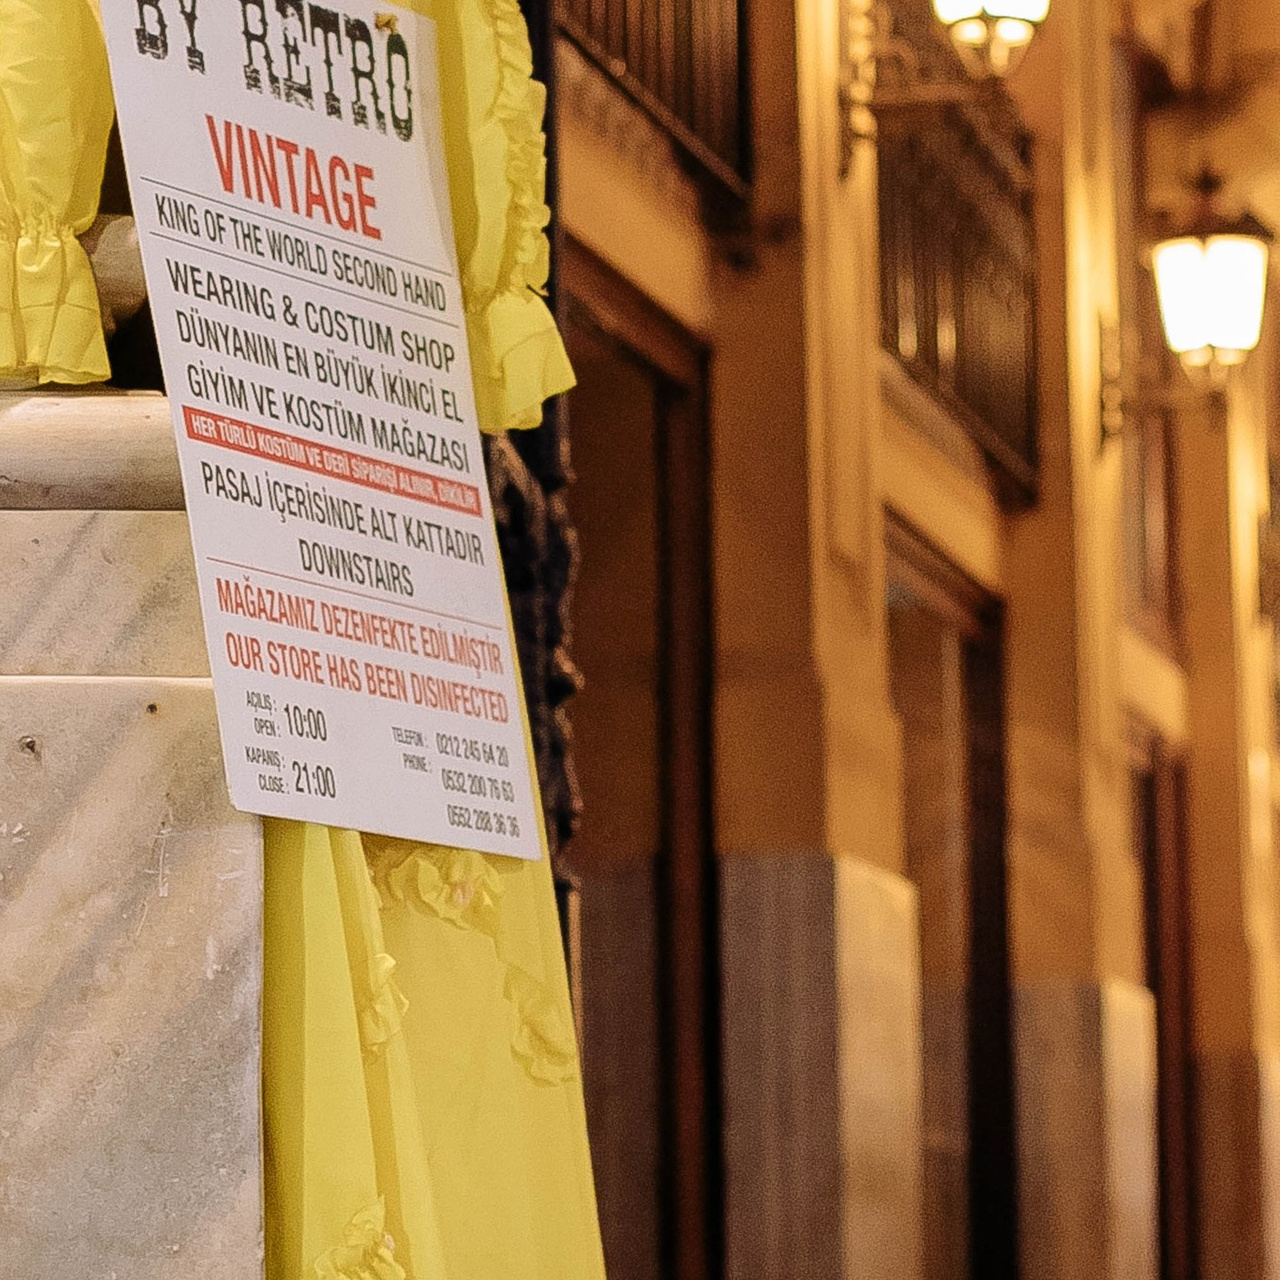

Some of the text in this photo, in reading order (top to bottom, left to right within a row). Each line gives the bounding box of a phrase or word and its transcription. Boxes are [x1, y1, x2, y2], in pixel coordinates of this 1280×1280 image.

[205, 113, 383, 240] VINTAGE
[155, 193, 447, 312] KING OF THE WORLD SECOND HAND
[165, 258, 456, 373] WEARING & COSTUM SHOP
[175, 307, 465, 424] DÜNYANIN EN BÜYÜK İKİNCİ EL
[187, 359, 471, 474] GİYİM VE KOSTÜM MAĞAZASI
[190, 413, 217, 439] HER
[217, 419, 257, 450] TÜRLÜ
[257, 432, 307, 464] KOSTÜM
[306, 446, 323, 468] VE
[200, 460, 486, 567] PASAJ İÇERİSİNDE ALT KATTADIR
[298, 538, 414, 598] DOWNSTAIRS
[216, 574, 505, 680] MAĞAZAMIZ DEZENFEKTE EDİLMİŞTİR
[225, 631, 510, 725] OUR STORE HAS BEEN DISINFECTED
[283, 703, 328, 742] 10:00
[291, 760, 337, 799] 21:00
[435, 732, 463, 759] 0212
[462, 738, 482, 763] 245
[496, 745, 510, 768] 20
[441, 768, 468, 795] 0532
